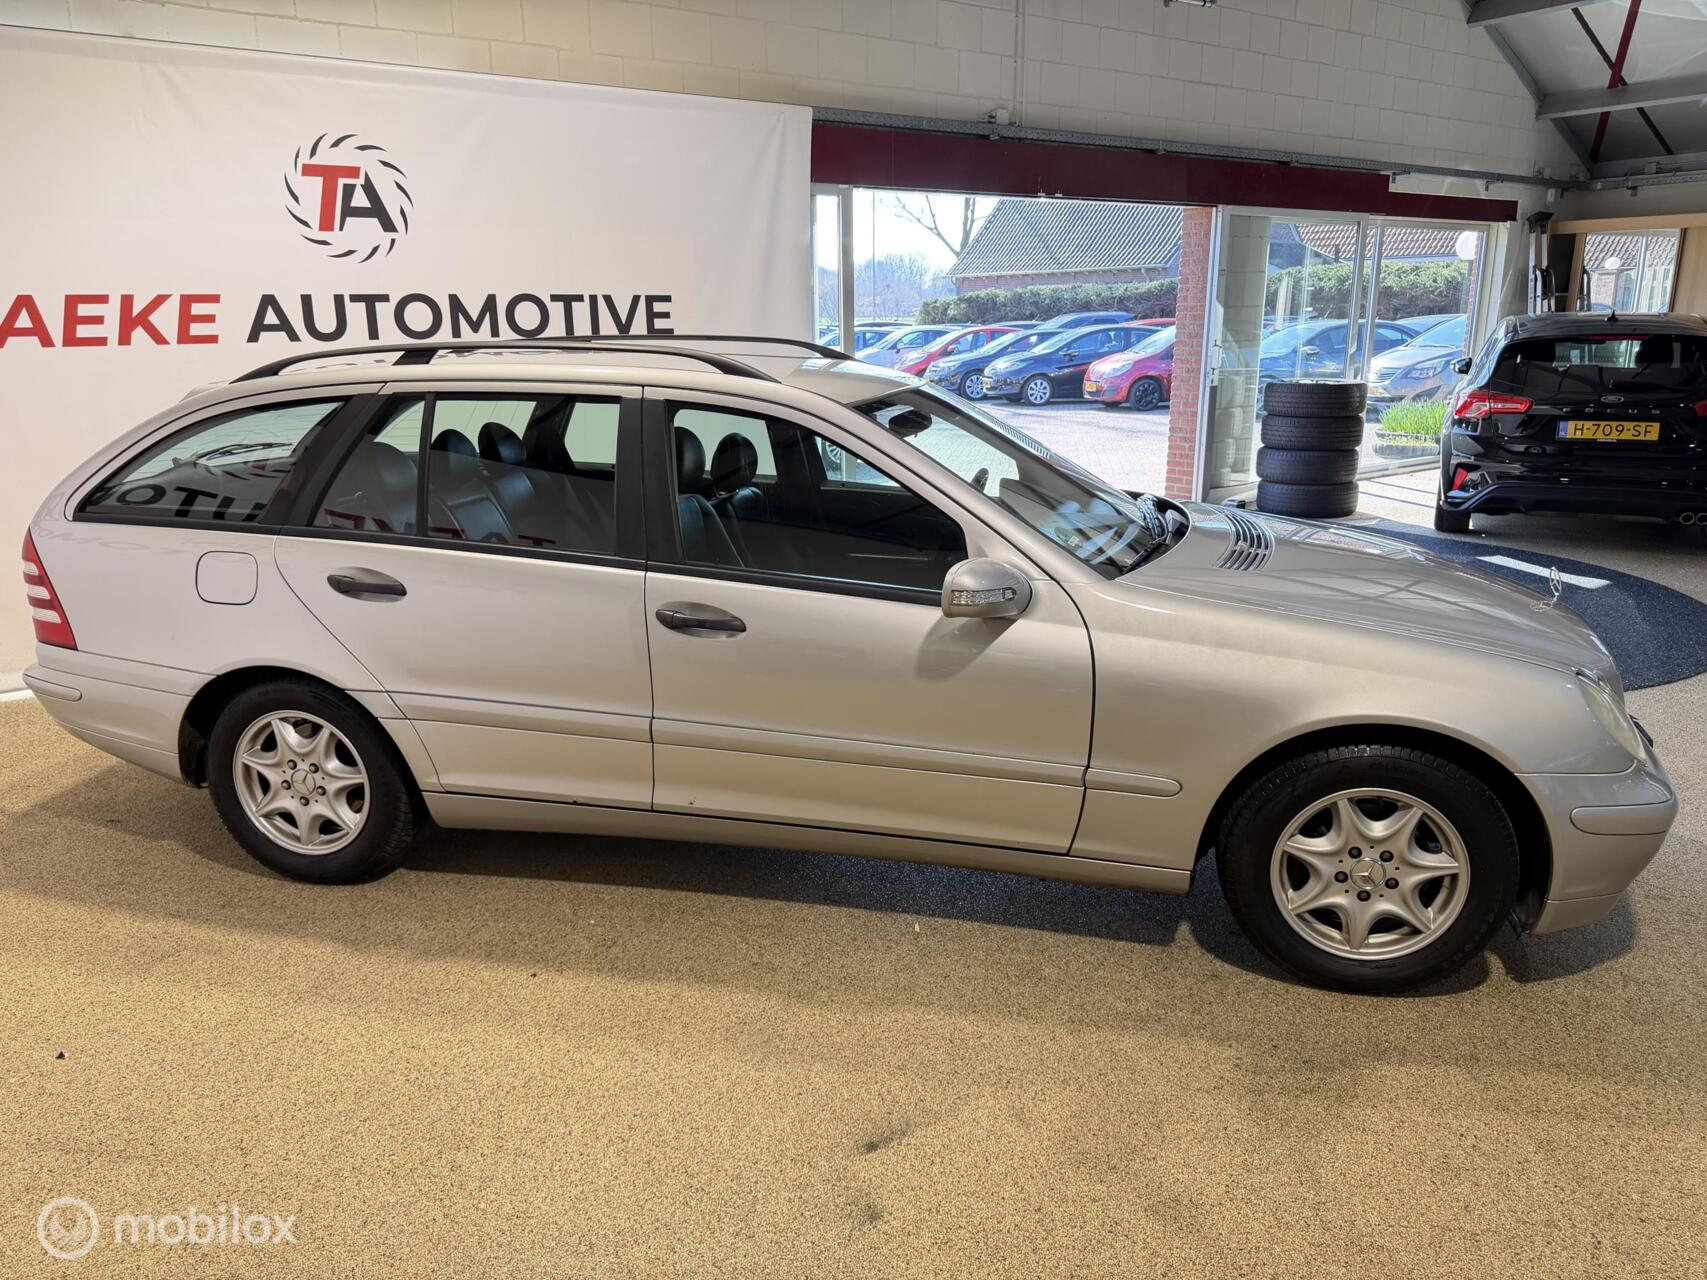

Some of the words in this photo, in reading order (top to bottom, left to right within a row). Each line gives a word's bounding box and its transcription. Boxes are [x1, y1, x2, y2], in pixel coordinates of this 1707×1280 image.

[0, 293, 221, 348] AEKE
[247, 292, 674, 344] AUTOMOTIVE
[1573, 423, 1654, 438] H-709-SF
